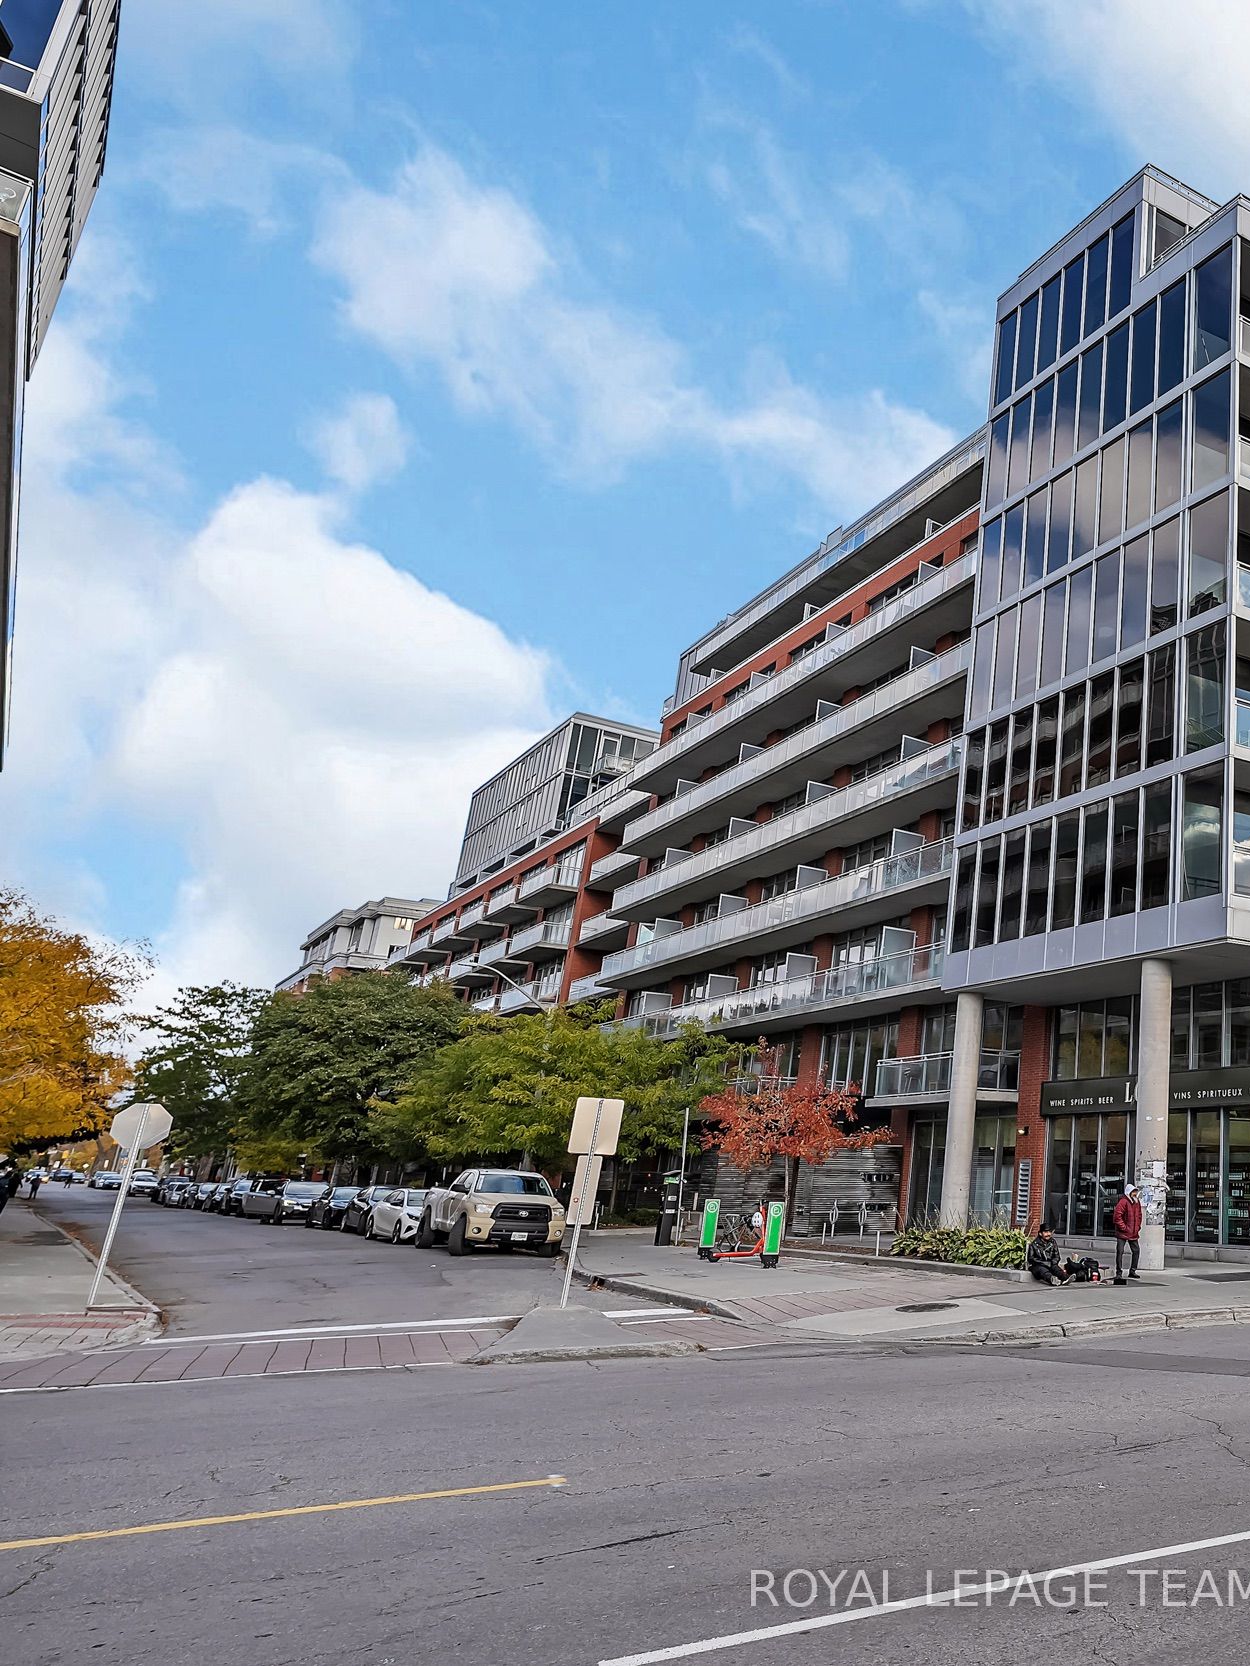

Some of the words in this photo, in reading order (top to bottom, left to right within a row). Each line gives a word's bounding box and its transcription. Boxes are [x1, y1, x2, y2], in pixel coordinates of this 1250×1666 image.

[1173, 1091, 1191, 1099] VINS
[1197, 1088, 1243, 1099] SPIRITUEUX
[1049, 1099, 1066, 1107] WINE
[1070, 1097, 1093, 1106] SPIRITS
[1098, 1096, 1114, 1104] BEER
